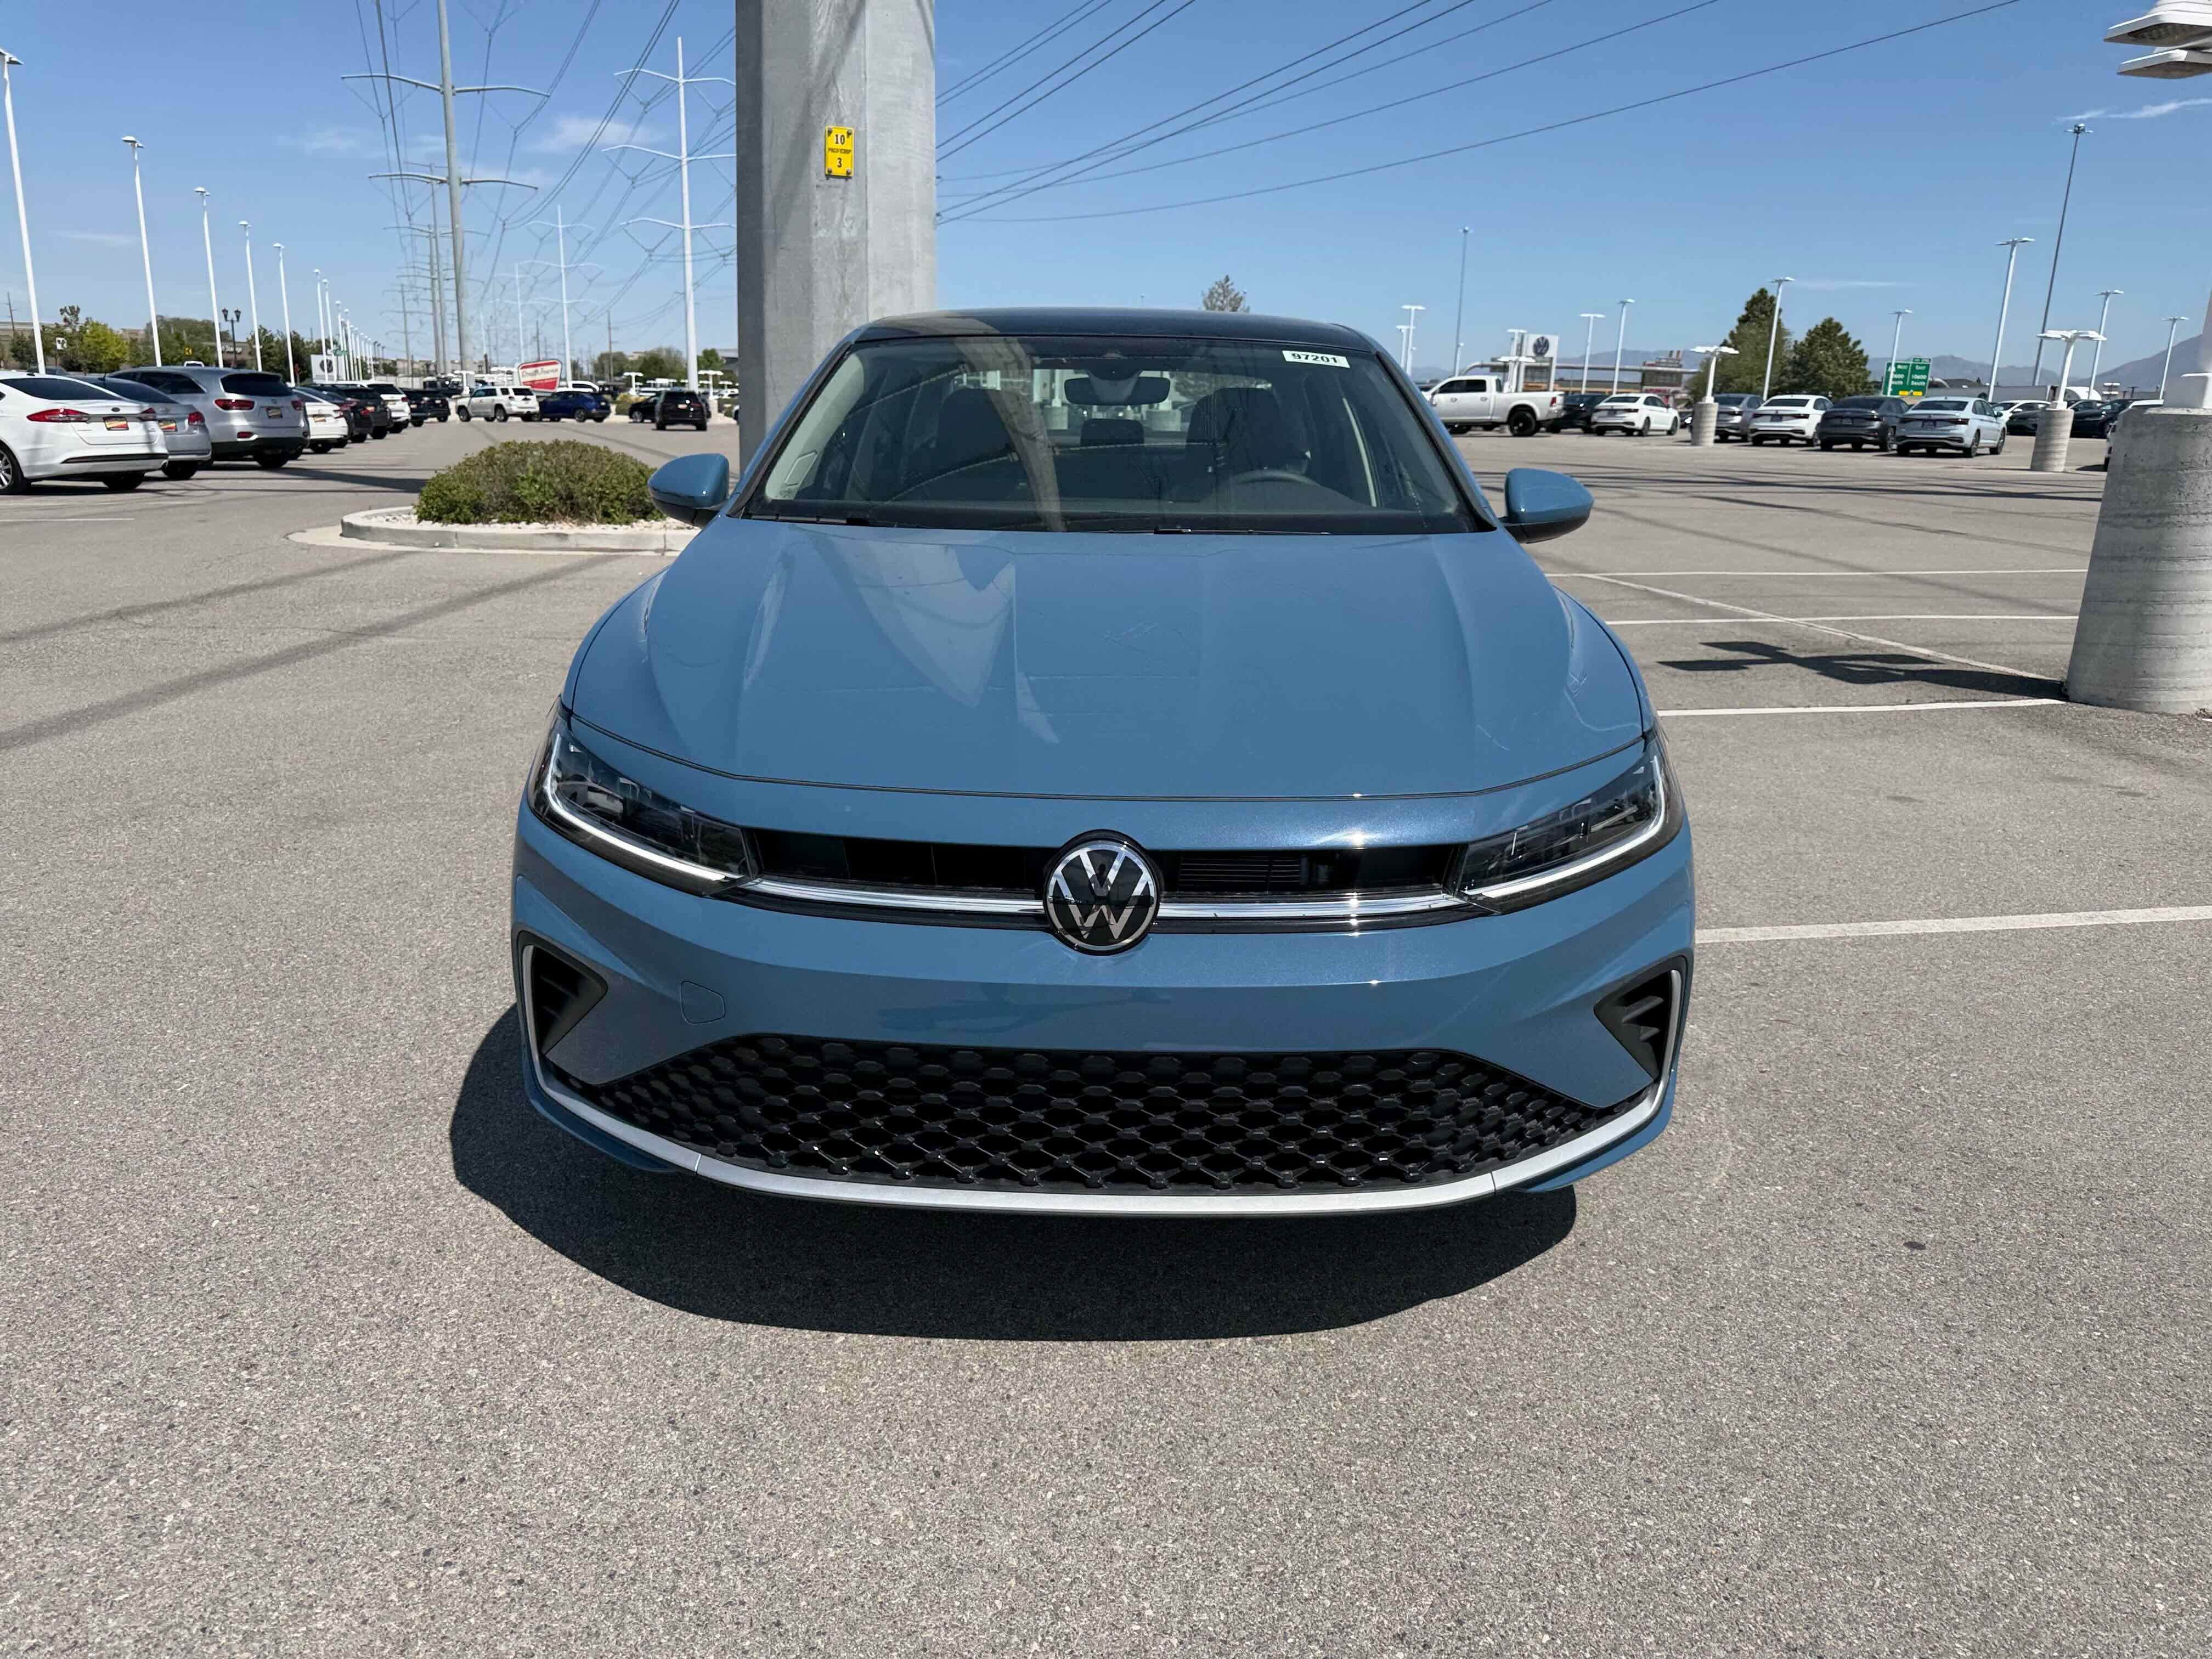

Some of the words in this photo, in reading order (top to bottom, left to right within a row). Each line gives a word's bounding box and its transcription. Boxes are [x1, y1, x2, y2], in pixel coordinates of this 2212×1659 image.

[835, 134, 845, 145] 10
[837, 157, 842, 168] 3
[1290, 353, 1338, 363] 97201
